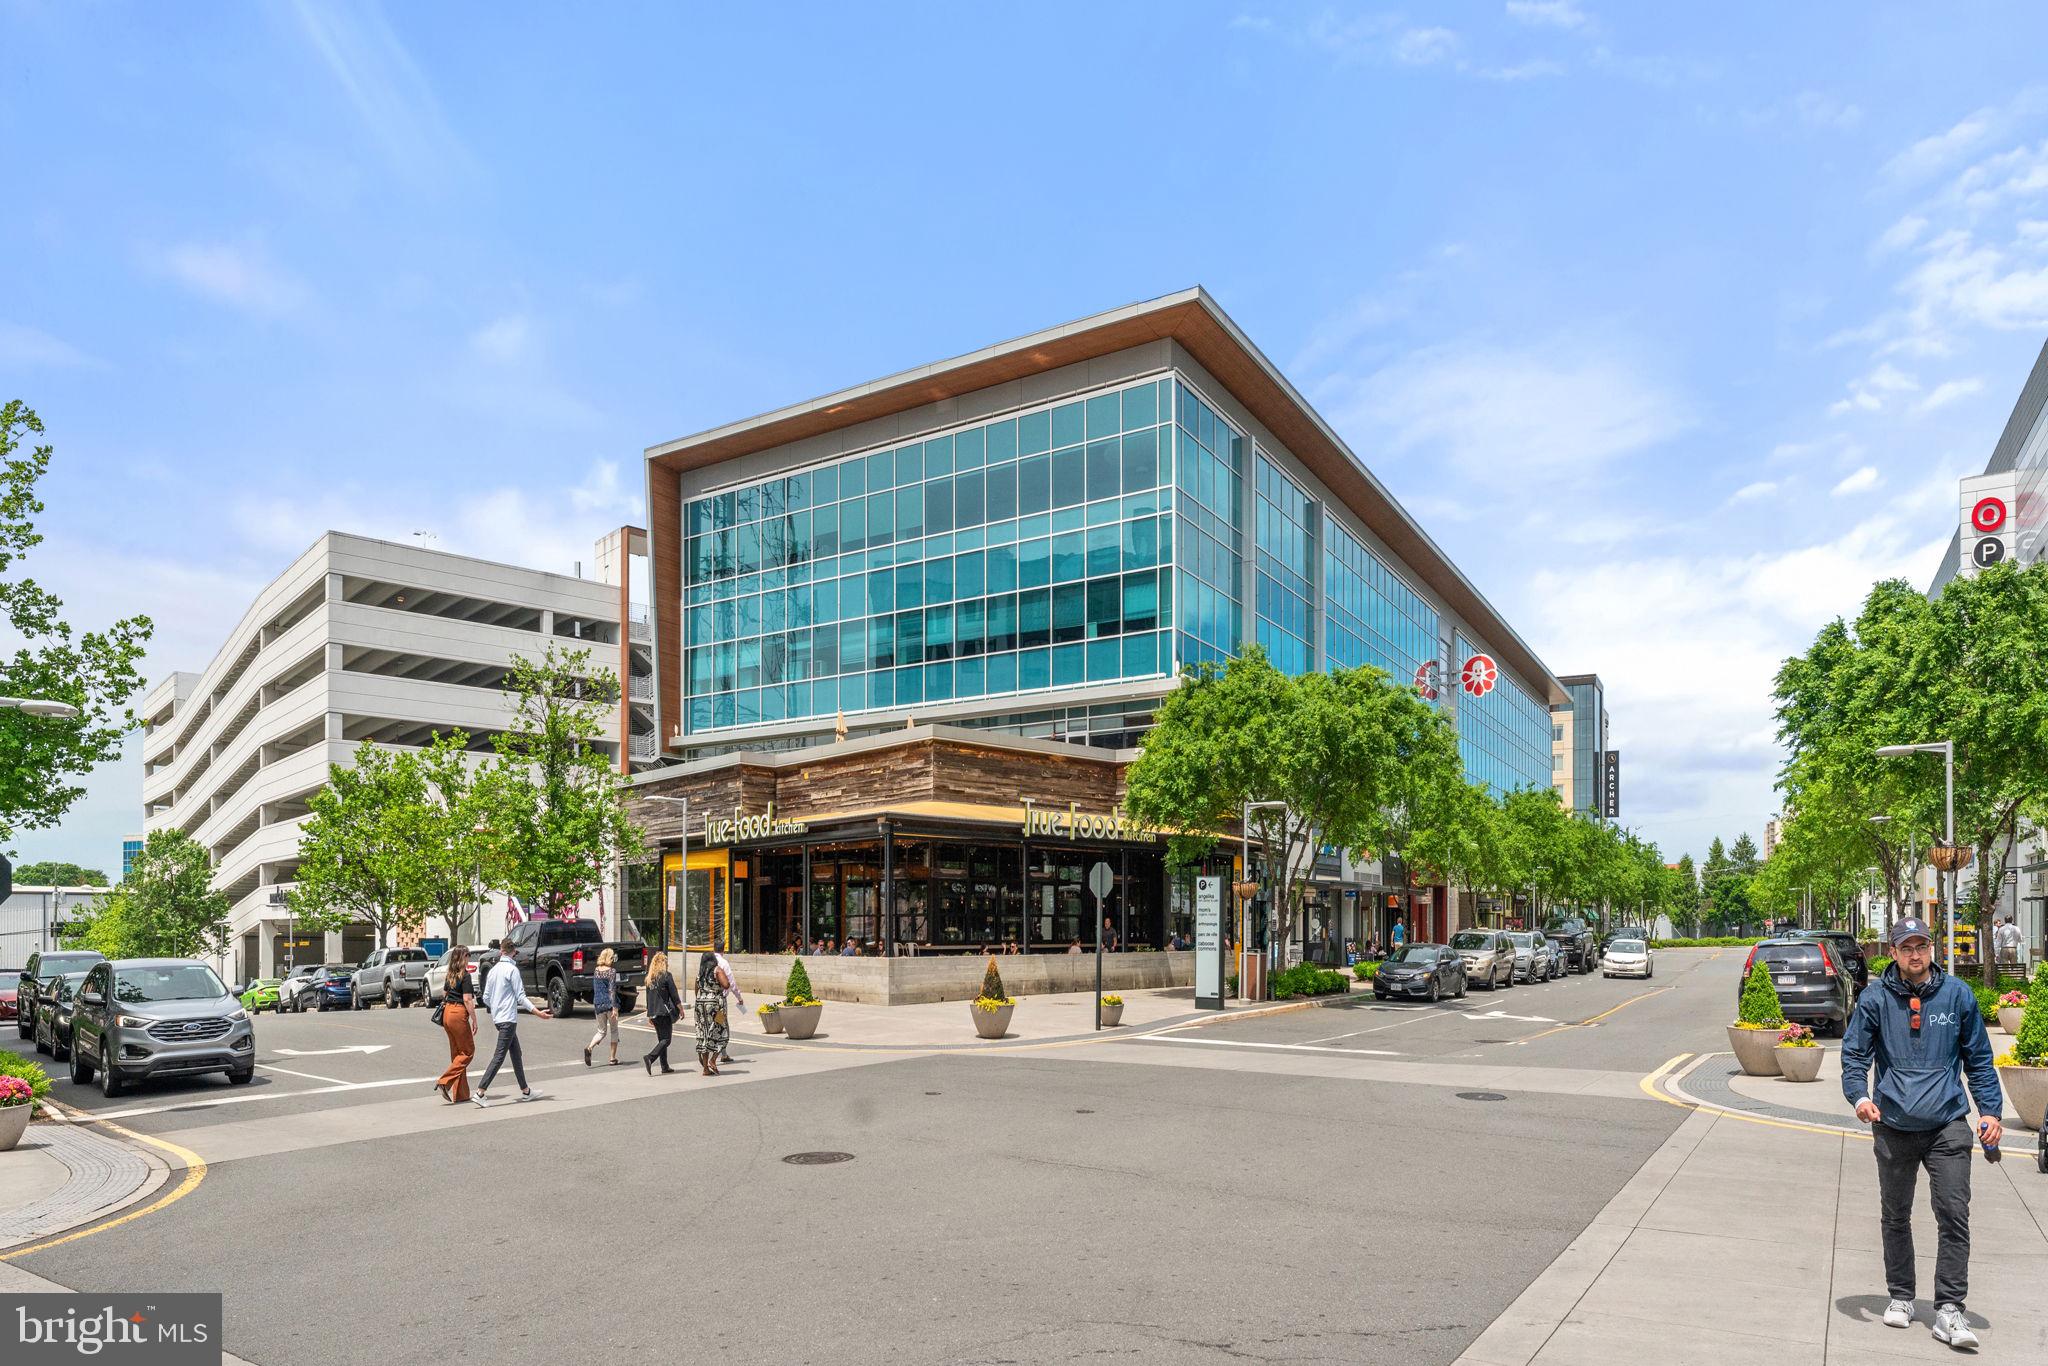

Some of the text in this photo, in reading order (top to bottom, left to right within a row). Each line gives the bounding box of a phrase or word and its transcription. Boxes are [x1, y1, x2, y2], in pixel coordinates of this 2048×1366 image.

[1983, 543, 1997, 562] P
[1608, 765, 1616, 816] ARCHER
[702, 800, 805, 848] True Food kitchen
[1020, 796, 1064, 838] True
[1069, 801, 1119, 841] Food
